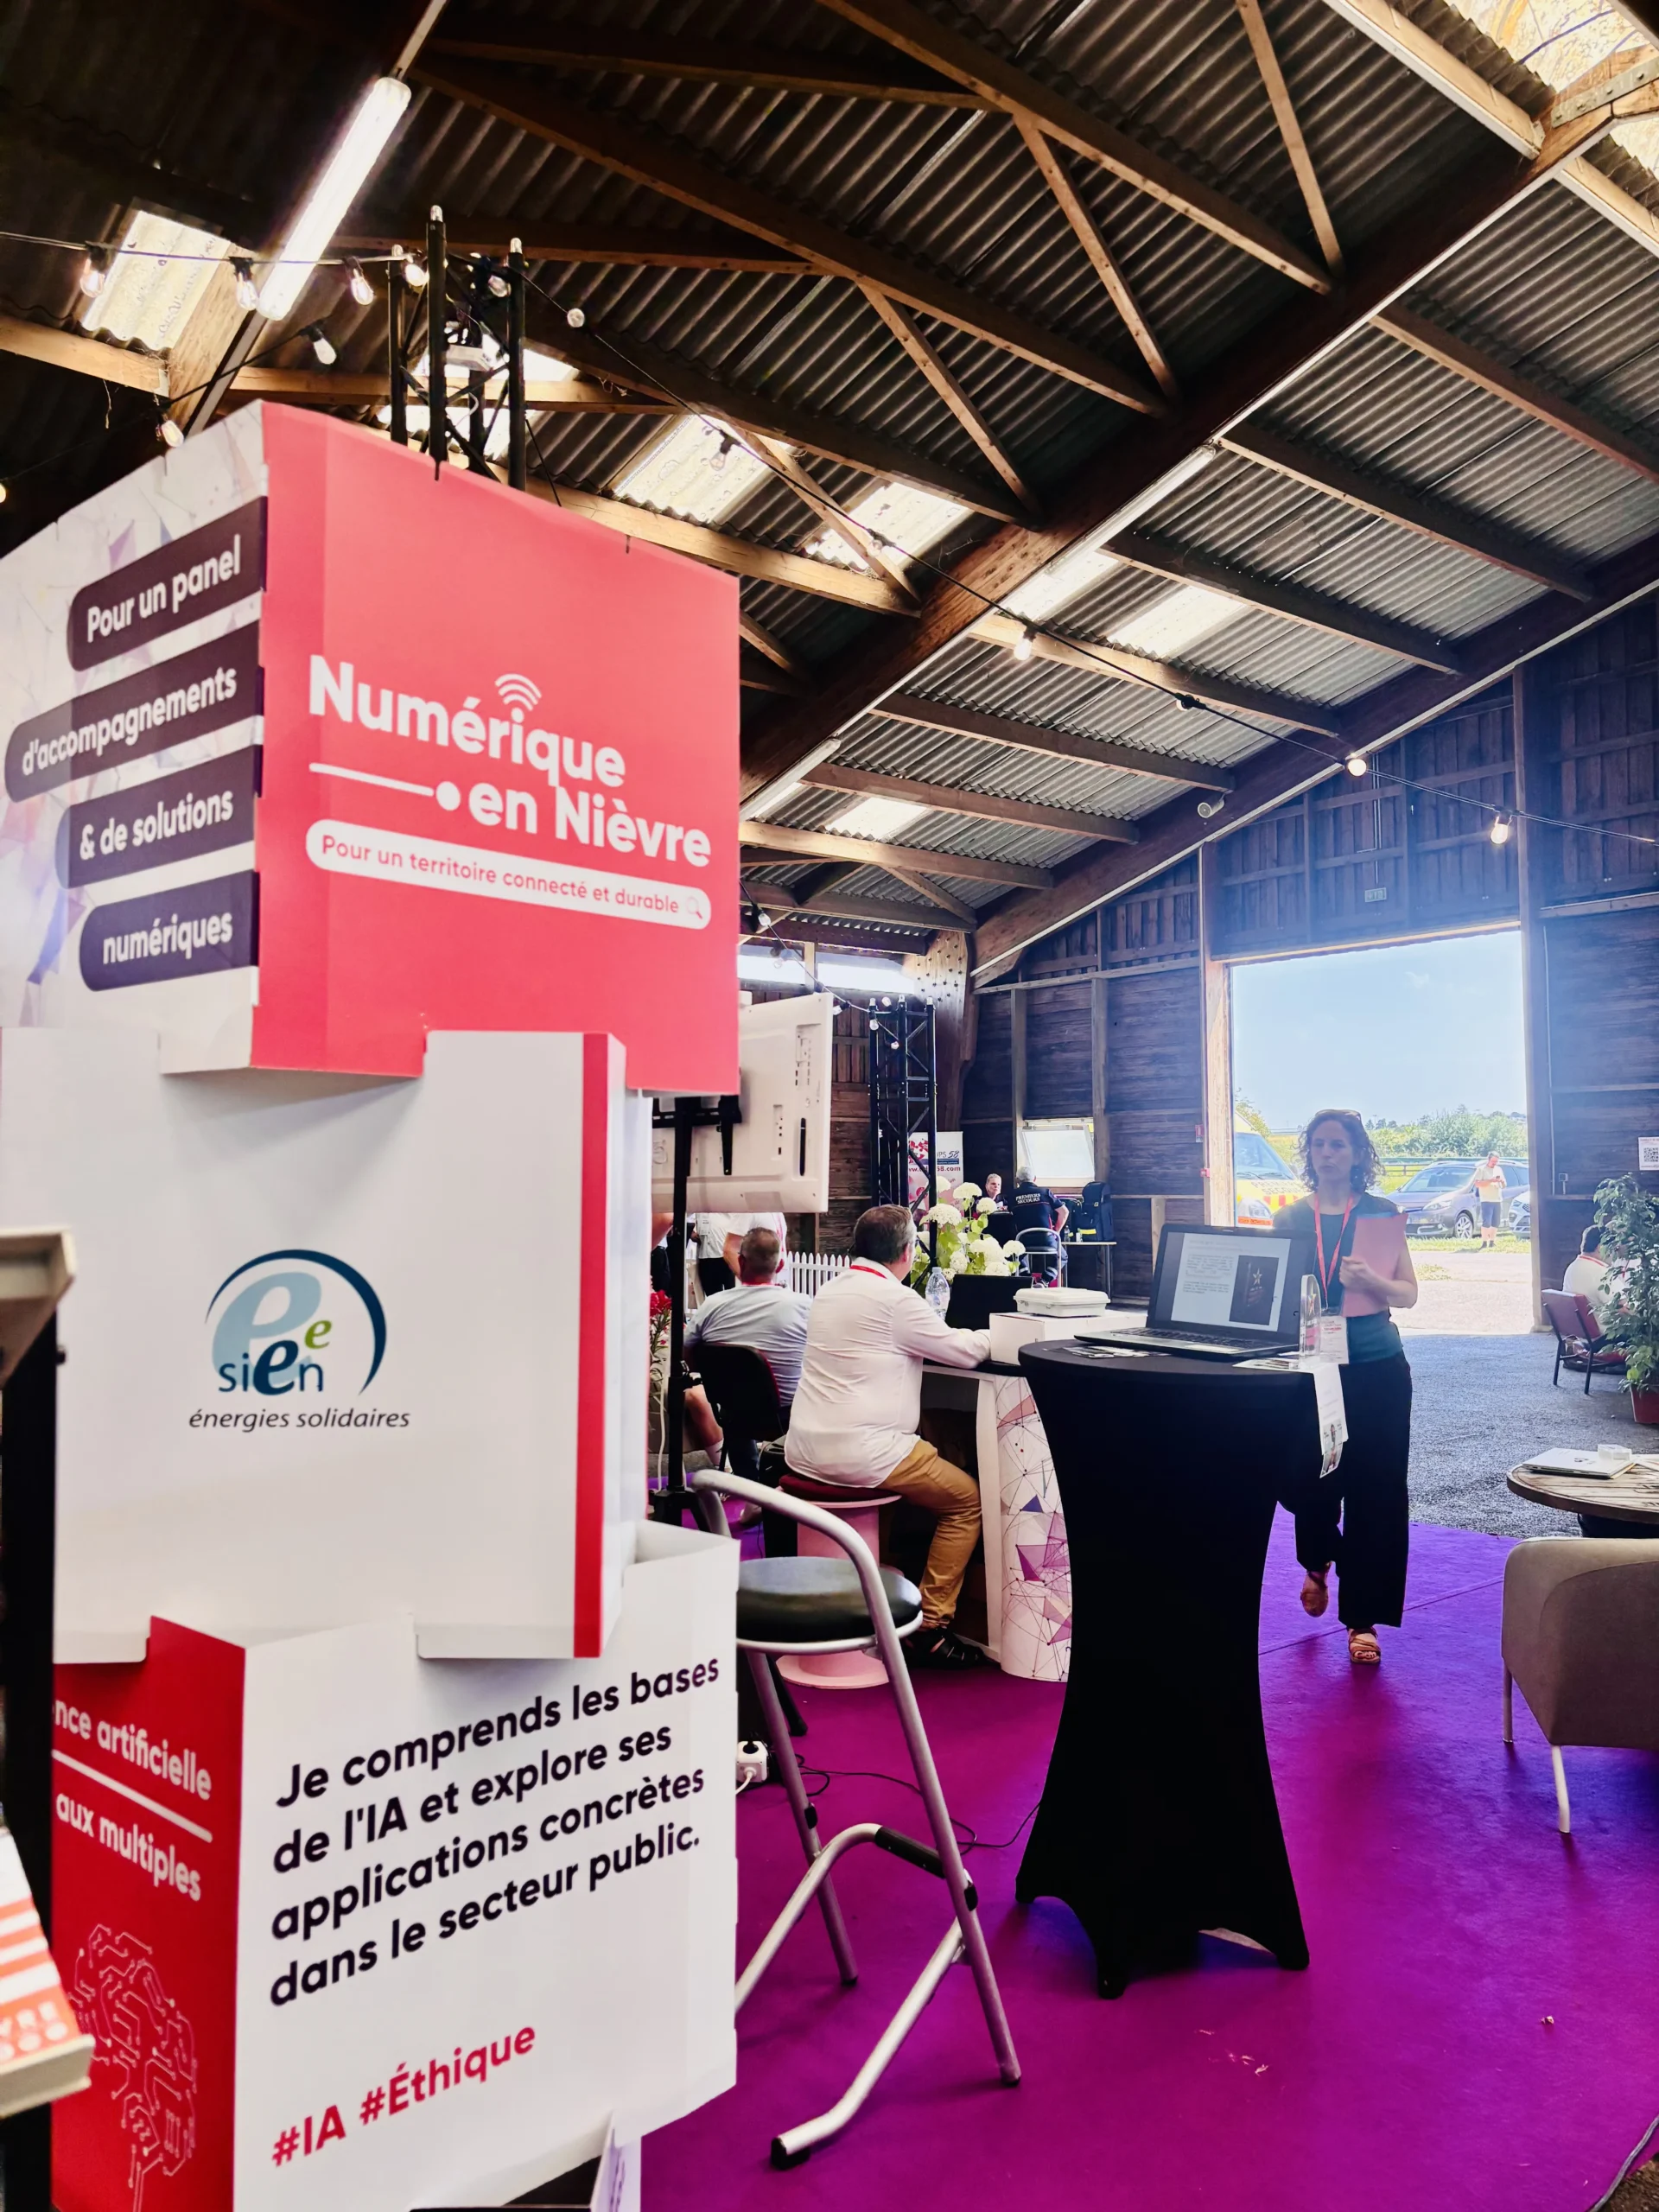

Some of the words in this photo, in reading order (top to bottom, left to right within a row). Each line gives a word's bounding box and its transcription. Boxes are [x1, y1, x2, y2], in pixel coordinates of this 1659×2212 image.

[87, 599, 135, 643] Pour
[139, 582, 167, 619] un
[172, 533, 241, 613] panel
[22, 667, 238, 776] d'accompagnements
[309, 655, 626, 787] Numérique
[79, 824, 96, 861] &
[99, 817, 128, 855] de
[132, 791, 234, 847] solutions
[322, 834, 371, 861] Pour
[378, 850, 403, 867] un
[410, 852, 497, 883] territoire
[503, 872, 588, 899] connecté
[593, 887, 609, 902] et
[615, 888, 679, 913] durable
[469, 784, 537, 834] en
[556, 785, 711, 868] Nièvre
[103, 912, 233, 964] numériques
[188, 1408, 290, 1433] énergies
[296, 1408, 410, 1428] solidaires
[53, 1700, 92, 1740] nce
[97, 1720, 213, 1802] artificielle
[276, 1764, 329, 1808] Je
[343, 1695, 561, 1786] comprends
[573, 1684, 620, 1720] les
[631, 1655, 720, 1705] bases
[56, 1793, 94, 1839] aux
[99, 1823, 201, 1902] multiples
[273, 1828, 330, 1873] de
[344, 1796, 408, 1851] l'IA
[420, 1781, 459, 1823] et
[471, 1745, 607, 1806] explore
[618, 1724, 672, 1762] ses
[271, 1824, 528, 1942] applications
[539, 1765, 705, 1843] concrètes
[270, 1941, 378, 2006] dans
[391, 1918, 426, 1959] le
[439, 1863, 579, 1939] secteur
[589, 1820, 701, 1892] public.
[271, 2104, 346, 2166] #IA
[359, 2026, 536, 2126] #Éthique
